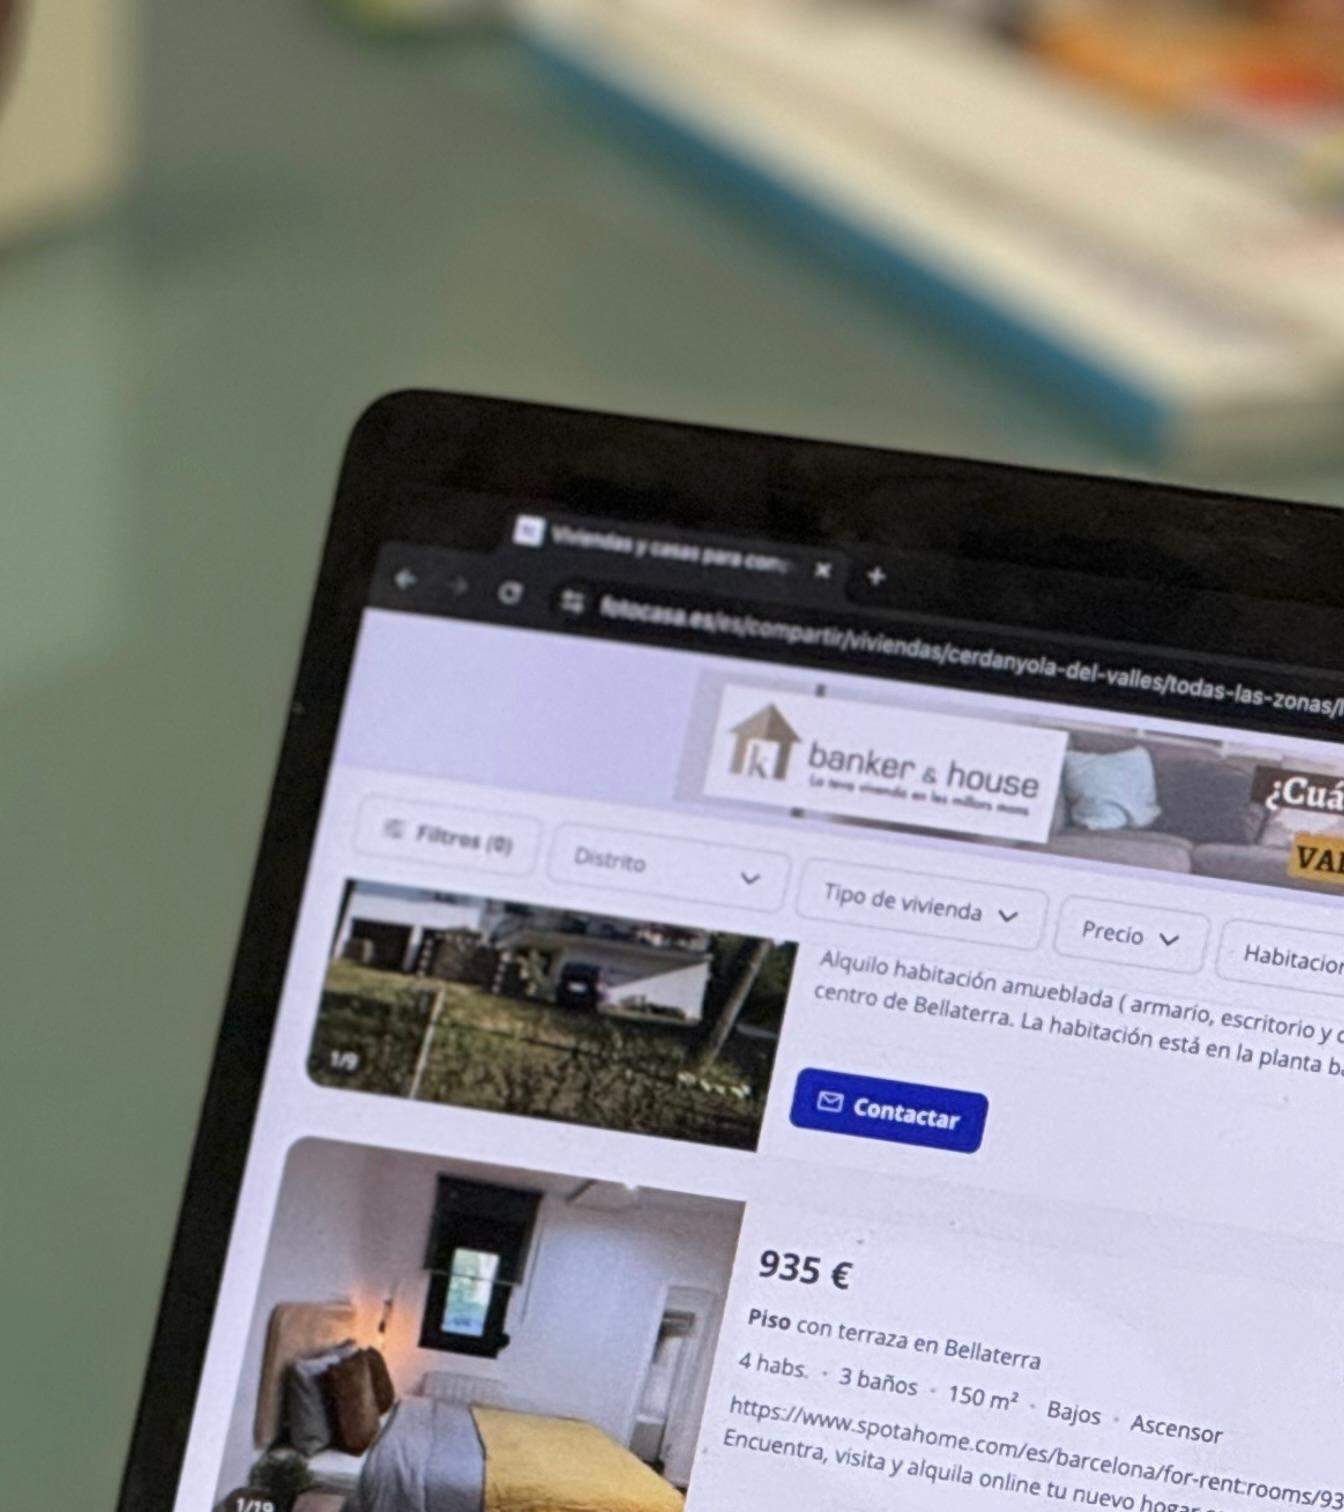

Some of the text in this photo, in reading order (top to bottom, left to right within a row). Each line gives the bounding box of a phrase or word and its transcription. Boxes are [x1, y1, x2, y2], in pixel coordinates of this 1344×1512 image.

[806, 740, 1040, 799] banker & house
[572, 844, 647, 874] Distrito
[824, 881, 983, 922] Tipo de vivienda
[1081, 918, 1144, 946] Precio
[818, 948, 890, 976] Alquilo
[892, 958, 997, 991] habitación
[1000, 978, 1114, 1009] amueblada
[1129, 998, 1215, 1027] armario,
[1219, 1011, 1316, 1039] escritorio
[1316, 1026, 1333, 1046] y
[812, 983, 878, 1007] centro
[881, 990, 909, 1011] de
[912, 994, 1014, 1027] Bellaterra.
[1019, 1011, 1044, 1032] La
[1047, 1014, 1153, 1048] habitación
[1157, 1035, 1201, 1055] está
[1204, 1042, 1231, 1060] en
[1235, 1042, 1254, 1063] la
[1257, 1047, 1322, 1073] planta
[852, 1096, 961, 1130] Contactar
[758, 1248, 853, 1290] 935 €
[746, 1306, 1042, 1371] Piso con terraza en Bellaterra
[737, 1351, 752, 1369] 4
[755, 1352, 808, 1379] habs.
[838, 1366, 853, 1386] 3
[856, 1368, 918, 1397] baños
[949, 1384, 986, 1407] 150
[1046, 1399, 1102, 1427] Bajos
[1128, 1413, 1224, 1445] Ascensor
[722, 1427, 828, 1465] Encuentra,
[834, 1449, 886, 1471] visita
[887, 1458, 904, 1478] y
[905, 1458, 973, 1485] alquila
[978, 1471, 1041, 1496] online
[1045, 1480, 1068, 1500] tu
[1071, 1487, 1135, 1511] nuevo
